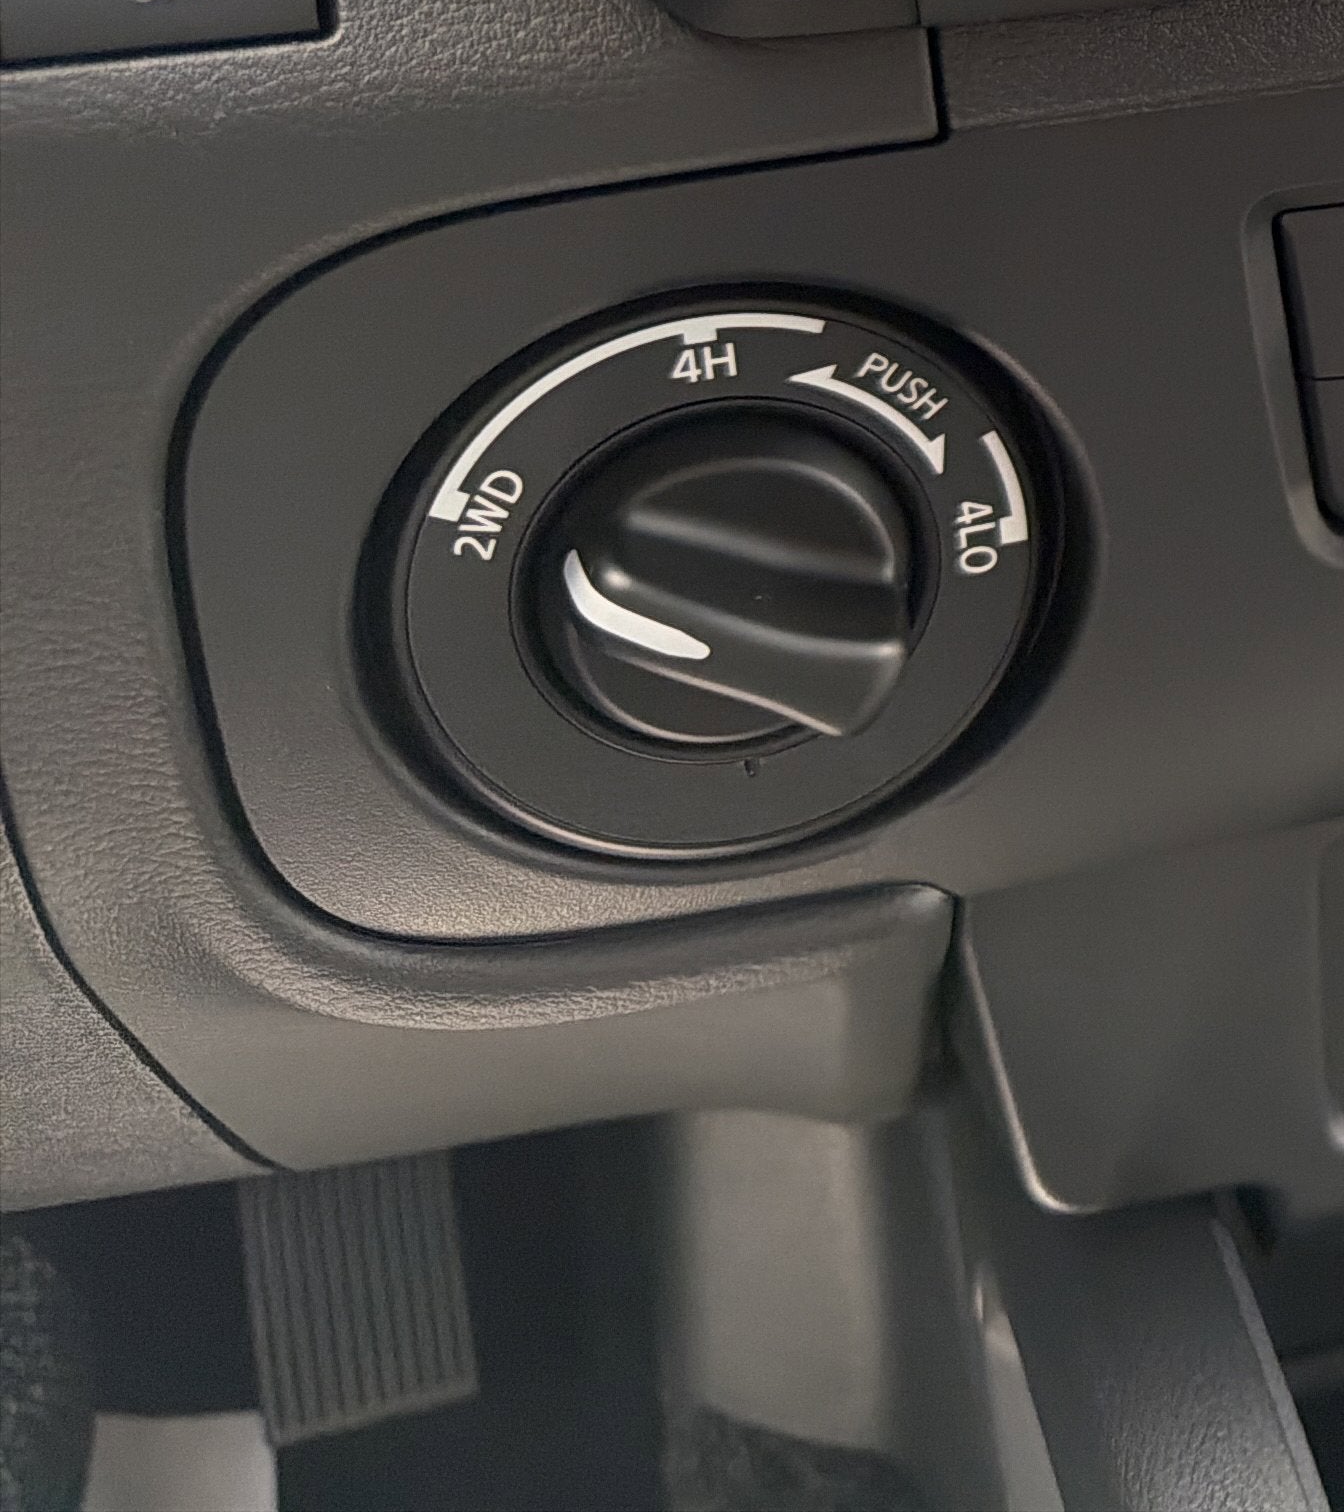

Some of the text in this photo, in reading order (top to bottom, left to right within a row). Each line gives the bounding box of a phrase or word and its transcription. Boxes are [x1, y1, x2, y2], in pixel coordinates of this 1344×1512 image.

[670, 343, 738, 384] 4H
[857, 351, 948, 420] PUSH
[453, 468, 525, 562] 2WD
[956, 498, 998, 575] 4LO
